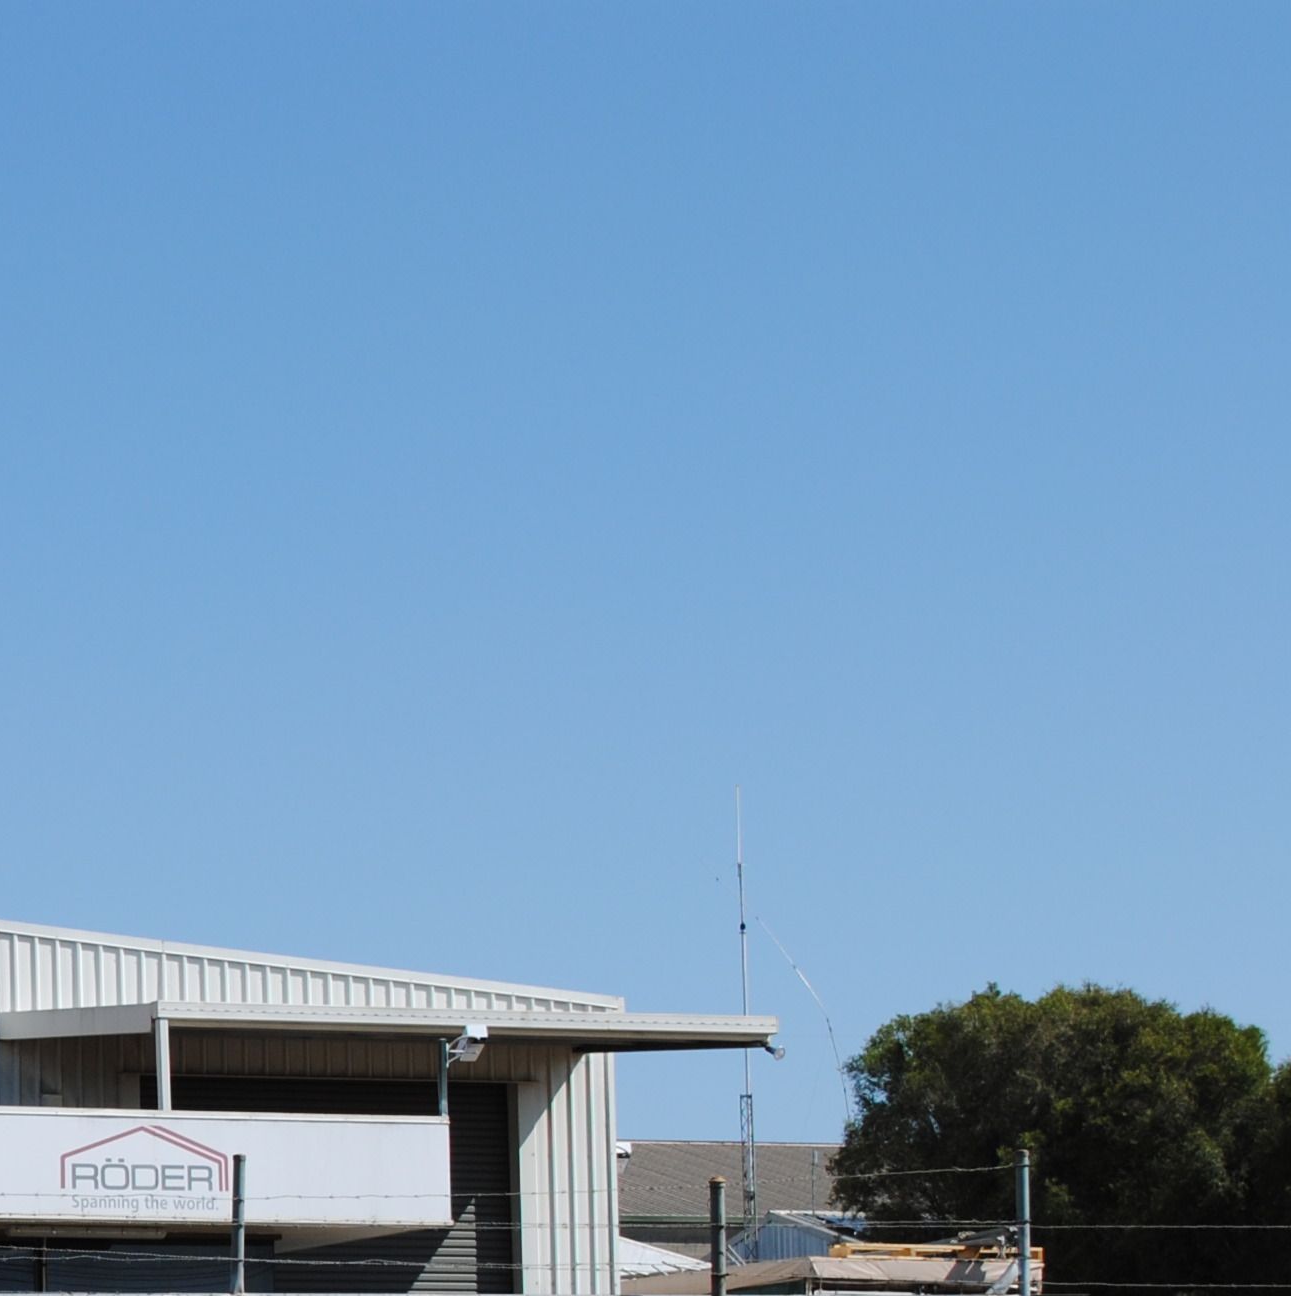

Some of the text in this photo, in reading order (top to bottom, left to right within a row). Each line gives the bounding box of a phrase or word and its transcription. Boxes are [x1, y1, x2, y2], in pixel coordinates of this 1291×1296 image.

[71, 1157, 214, 1191] RÖDER
[71, 1194, 220, 1213] Spanning the world.
